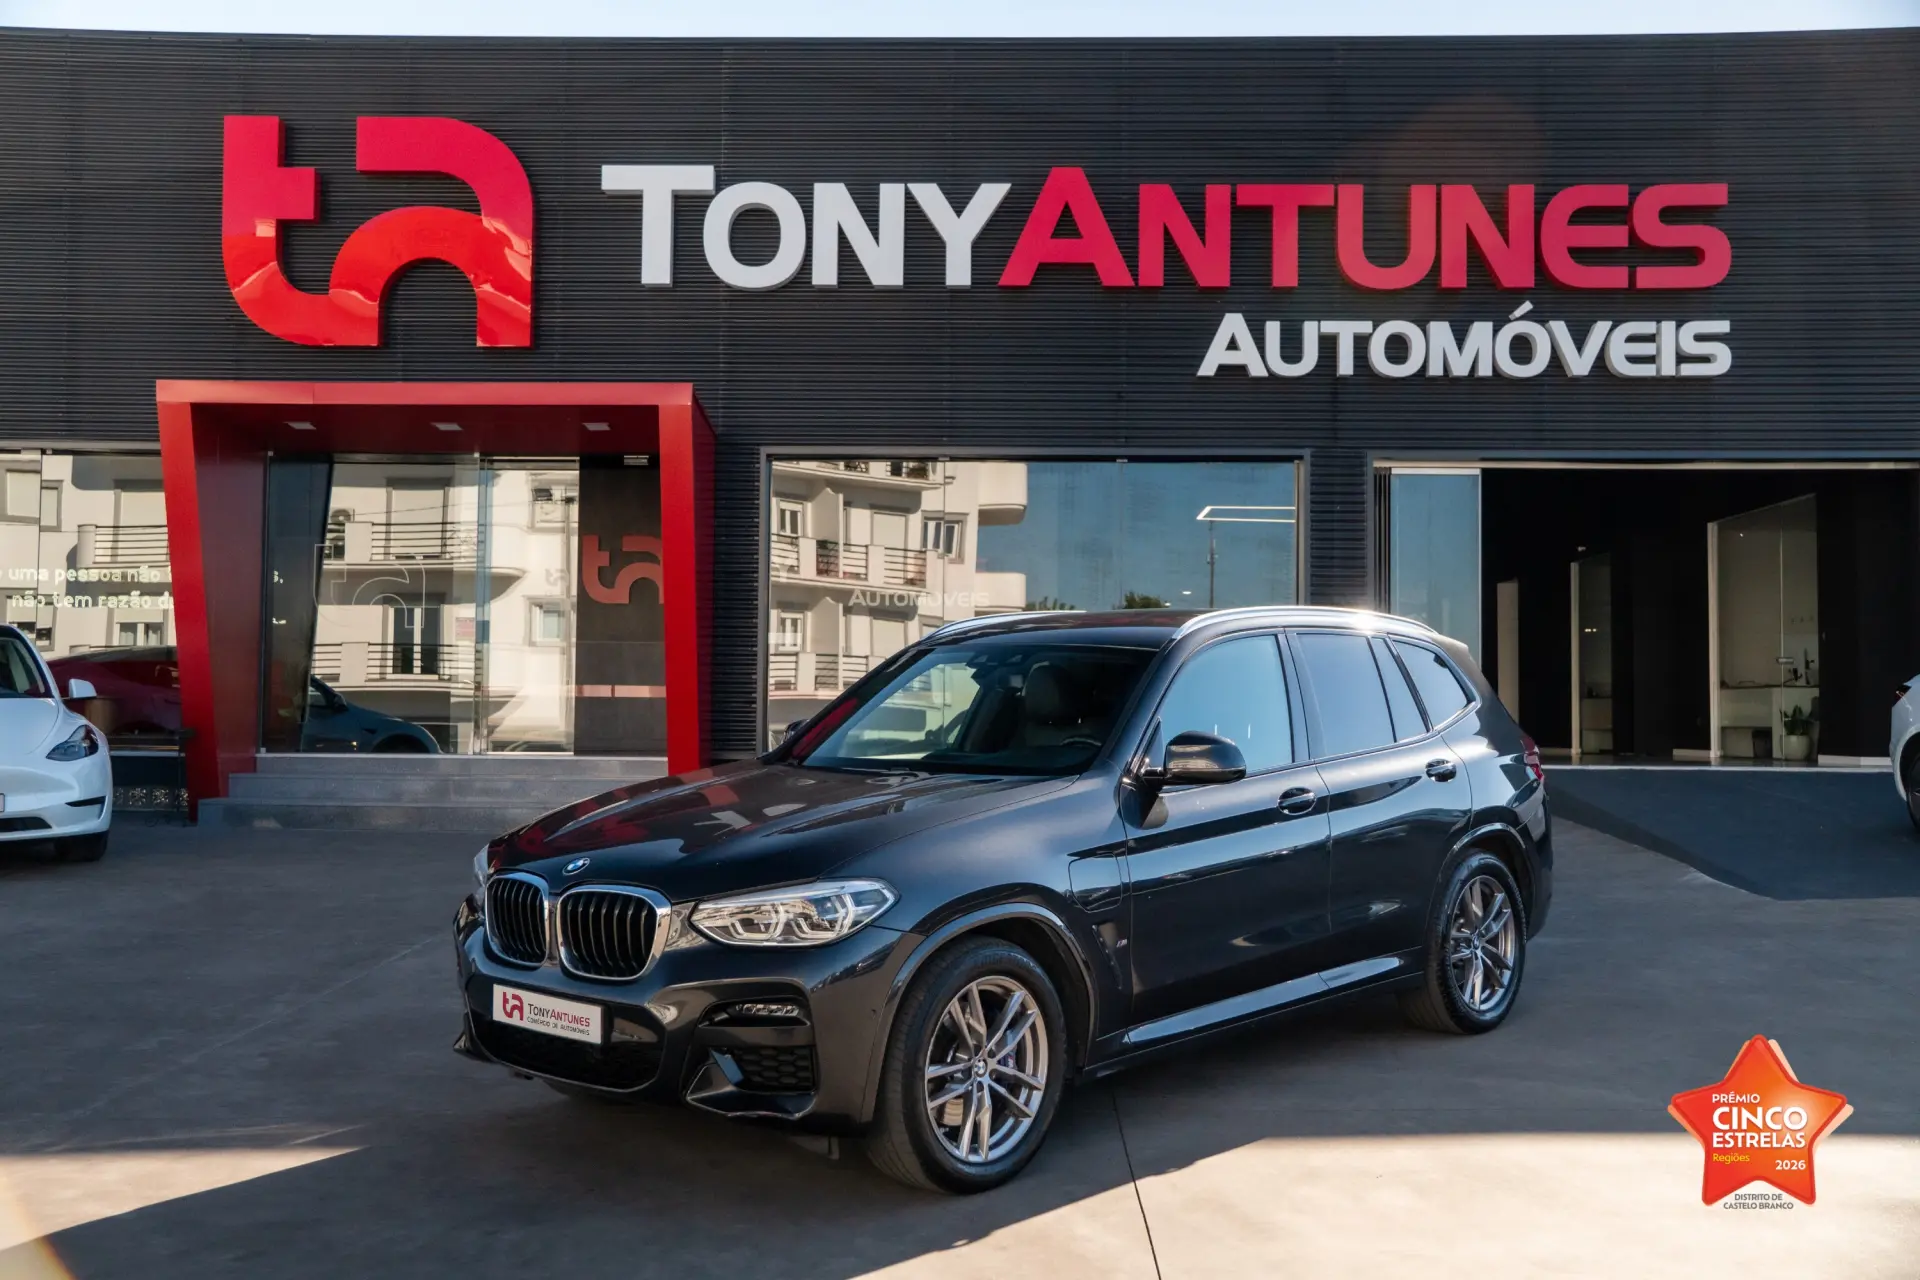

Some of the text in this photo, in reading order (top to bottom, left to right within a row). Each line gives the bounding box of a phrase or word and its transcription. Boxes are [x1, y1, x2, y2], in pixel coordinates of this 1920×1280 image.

[1196, 301, 1732, 379] AUTOMÓVEIS
[8, 567, 49, 581] uma
[54, 567, 122, 585] pessoa
[127, 565, 161, 583] não
[12, 591, 46, 608] não
[53, 592, 92, 608] tem
[98, 590, 151, 609] razão
